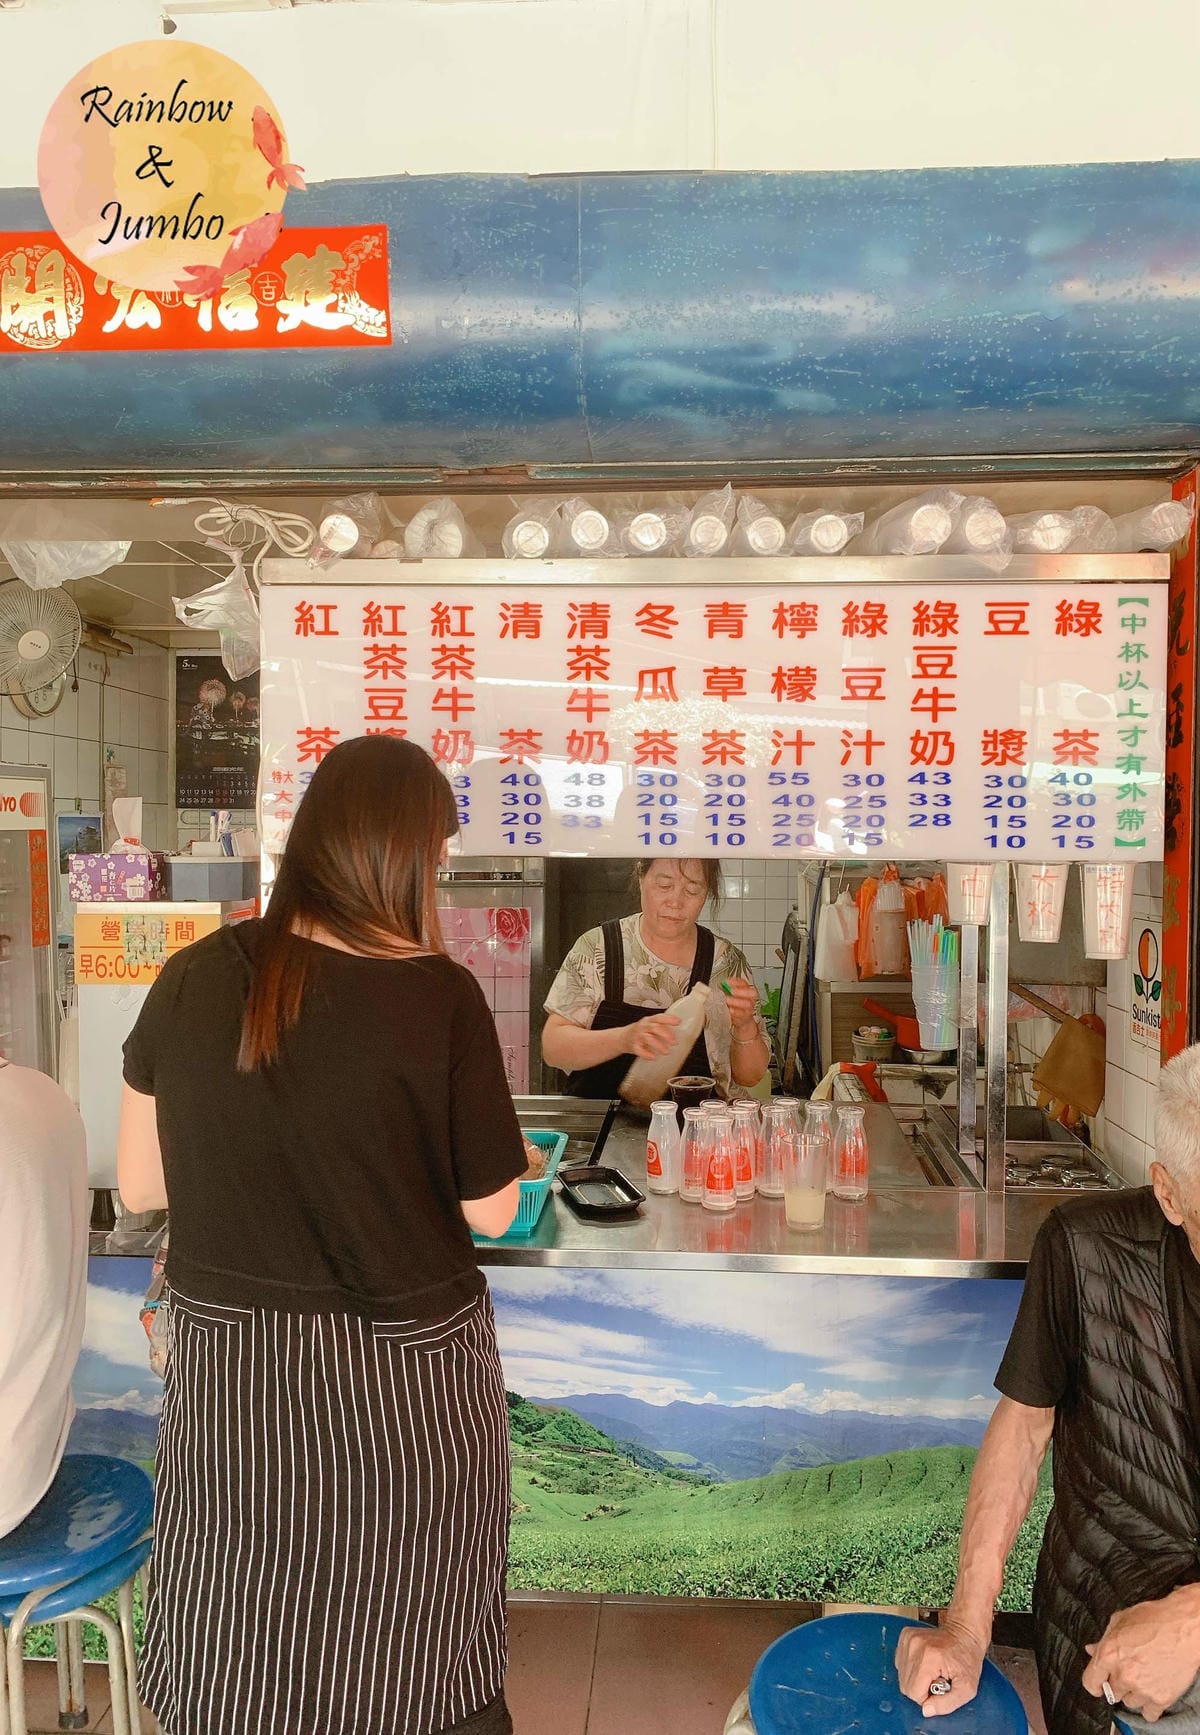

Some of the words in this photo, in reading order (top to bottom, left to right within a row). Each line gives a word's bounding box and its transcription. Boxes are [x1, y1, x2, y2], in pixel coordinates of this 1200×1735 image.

[362, 600, 408, 739] 紅茶豆
[430, 600, 476, 765] 紅茶牛奶
[498, 601, 544, 766] 清茶
[566, 601, 611, 765] 清茶牛奶
[634, 601, 680, 766] 冬瓜茶
[702, 601, 749, 767] 青草茶
[770, 600, 820, 767] 檸檬汁
[839, 600, 890, 767] 綠豆汁
[909, 599, 961, 767] 綠豆牛奶
[980, 600, 1031, 768] 豆漿
[1052, 598, 1104, 767] 綠茶
[500, 773, 542, 787] 40
[563, 772, 606, 786] 48
[636, 773, 678, 788] 30
[704, 773, 746, 788] 30
[767, 772, 810, 786] 55
[842, 773, 886, 788] 30
[907, 771, 952, 786] 43
[983, 774, 1028, 789] 30
[1048, 772, 1094, 787] 40
[273, 790, 293, 804] 大
[501, 792, 542, 806] 30
[563, 794, 605, 808] 38
[635, 793, 679, 807] 20
[703, 793, 746, 808] 20
[771, 793, 815, 808] 40
[844, 795, 888, 809] 25
[908, 793, 952, 808] 33
[983, 794, 1028, 809] 20
[1052, 793, 1097, 807] 30
[501, 812, 542, 826] 20
[561, 815, 603, 829] 33
[637, 813, 679, 827] 15
[704, 813, 747, 828] 15
[772, 813, 816, 828] 25
[842, 814, 886, 829] 20
[907, 813, 952, 828] 28
[984, 815, 1027, 829] 15
[1051, 814, 1096, 829] 20
[502, 831, 543, 845] 15
[637, 832, 678, 846] 10
[704, 832, 746, 847] 10
[771, 833, 815, 848] 20
[842, 832, 884, 847] 15
[983, 834, 1027, 849] 10
[1051, 834, 1095, 849] 15
[1132, 1003, 1161, 1029] Sunkist
